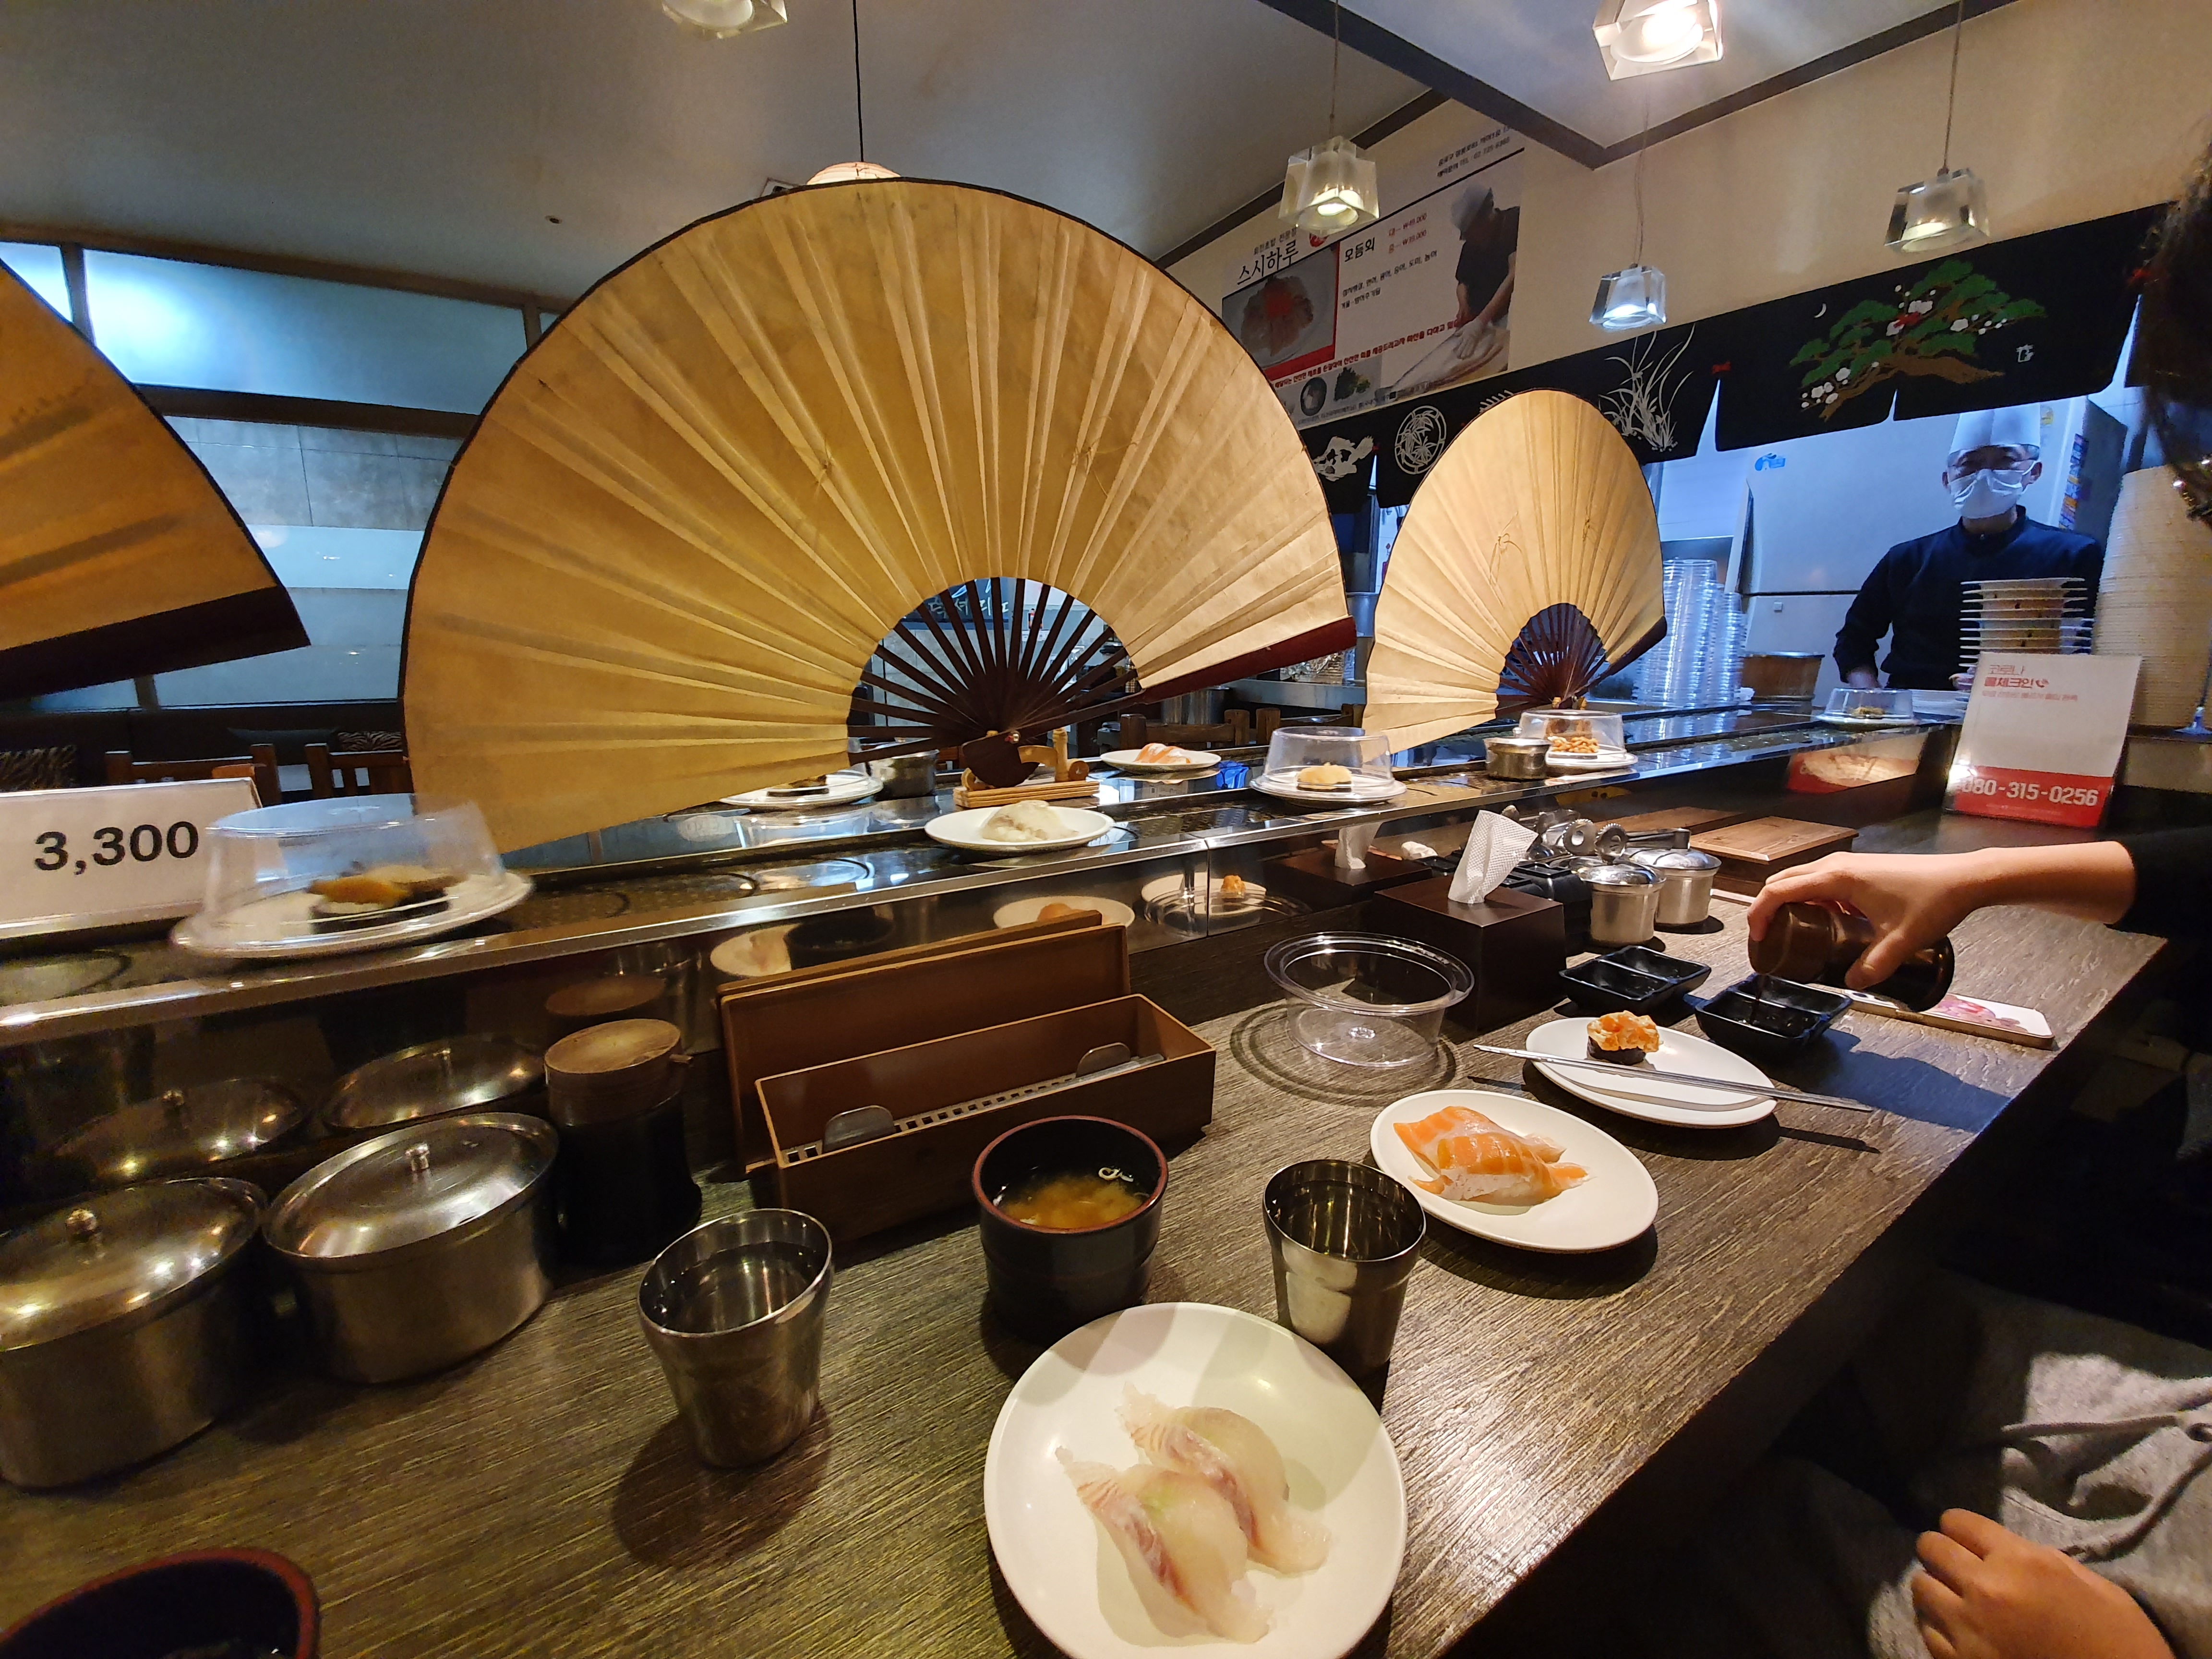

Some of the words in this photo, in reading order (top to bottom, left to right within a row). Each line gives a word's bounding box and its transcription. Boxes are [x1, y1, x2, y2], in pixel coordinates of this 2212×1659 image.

[1237, 239, 1299, 286] 스시하루
[1961, 778, 2099, 806] 080-315-0256
[35, 821, 199, 875] 3,300
